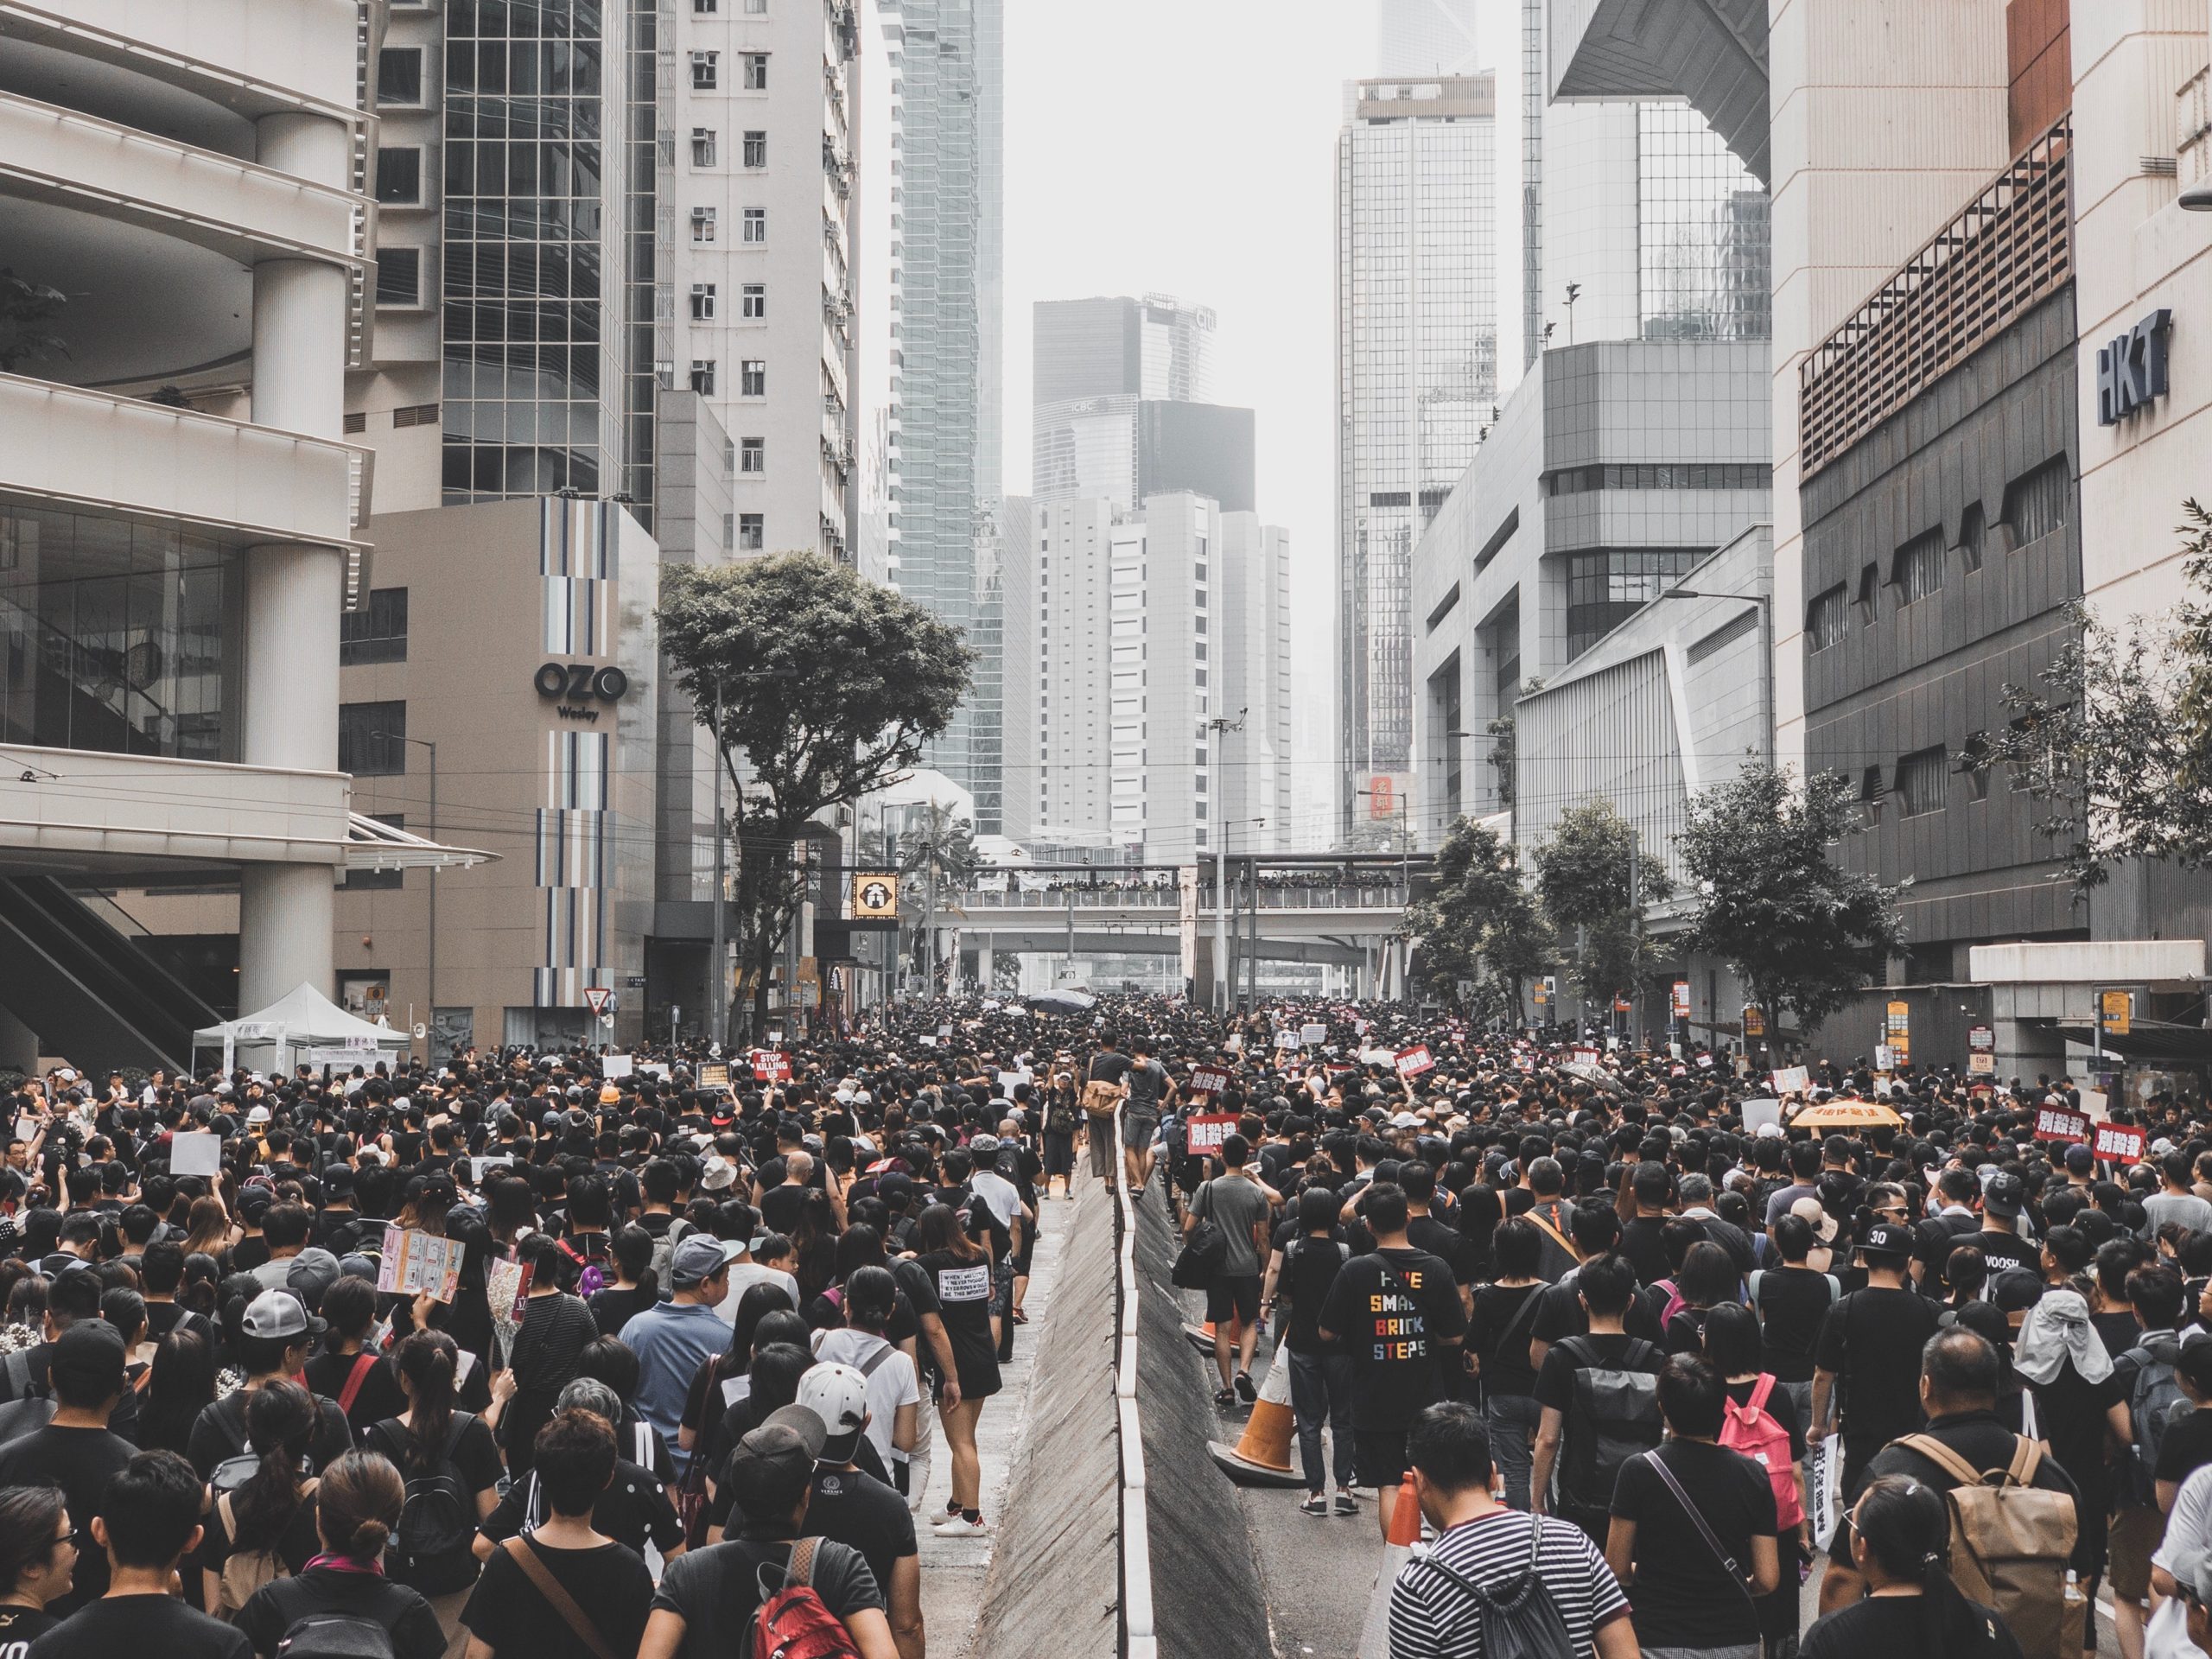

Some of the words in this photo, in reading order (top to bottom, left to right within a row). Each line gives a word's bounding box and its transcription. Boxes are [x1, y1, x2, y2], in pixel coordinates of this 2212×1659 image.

[2096, 309, 2172, 427] HKT
[1071, 401, 1093, 413] ICBC
[534, 662, 627, 701] OZO
[556, 705, 600, 724] Wesley
[756, 1061, 788, 1071] KILLING
[760, 1053, 782, 1063] STOP
[766, 1071, 779, 1079] US
[1190, 1071, 1227, 1091] 別殺我
[2037, 1109, 2085, 1138] 別殺我
[2096, 1128, 2141, 1158] 別殺我
[1870, 1230, 1887, 1245] 30
[1985, 1255, 2019, 1269] VOOSH
[966, 1287, 988, 1296] IMPORTANT
[1376, 1316, 1425, 1337] BRICK
[1373, 1339, 1427, 1361] STEPS
